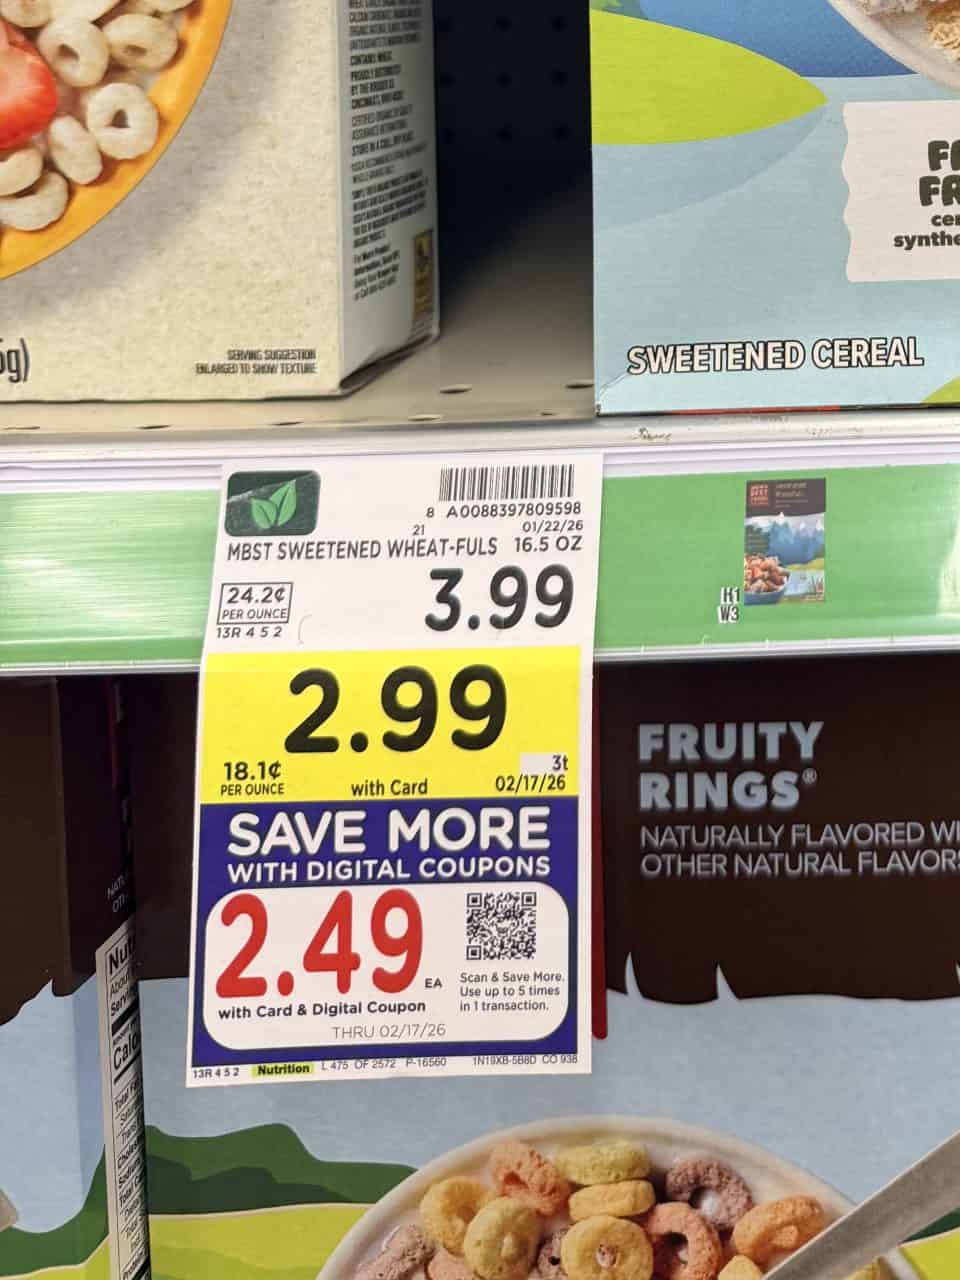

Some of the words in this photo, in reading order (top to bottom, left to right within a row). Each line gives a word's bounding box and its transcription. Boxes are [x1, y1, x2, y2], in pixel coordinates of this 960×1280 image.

[627, 339, 805, 375] SWEETENED
[812, 336, 924, 368] CEREAL
[426, 507, 435, 517] 8
[447, 502, 582, 517] A0088397809598
[412, 525, 425, 536] 21
[522, 519, 583, 534] 01/22/26
[227, 543, 271, 561] MBST
[278, 539, 380, 560] SWEETENED
[388, 537, 497, 557] WHEAT-FULS
[514, 536, 550, 553] 16.5
[555, 535, 582, 551] OZ
[227, 586, 285, 605] 24.2¢
[425, 564, 574, 631] 3.99
[222, 609, 244, 620] PER
[247, 608, 288, 619] OUNCE
[217, 627, 242, 638] 13R
[245, 627, 255, 638] 4
[259, 627, 269, 638] 5
[273, 626, 282, 637] 2
[285, 664, 507, 753] 2.99
[638, 720, 824, 761] FRUITY
[223, 760, 281, 780] 18.1¢
[552, 755, 569, 771] 3t
[221, 784, 243, 796] PER
[246, 783, 284, 795] OUNCE
[351, 780, 387, 796] with
[391, 779, 428, 796] Card
[495, 775, 566, 791] 02/17/26
[227, 809, 367, 856] SAVE
[388, 806, 551, 853] MORE
[640, 823, 786, 849] NATURALLY
[791, 821, 925, 847] FLAVORED
[227, 862, 298, 884] WITH
[306, 858, 410, 882] DIGITAL
[418, 855, 550, 879] COUPONS
[640, 852, 727, 877] OTHER
[733, 851, 851, 875] NATURAL
[216, 889, 423, 999] 2.49
[424, 978, 442, 989] EA
[460, 972, 488, 983] Scan
[491, 972, 499, 982] &
[503, 972, 530, 982] Save
[534, 972, 565, 982] More.
[460, 986, 481, 997] Use
[485, 987, 500, 999] up
[503, 986, 515, 996] to
[519, 986, 526, 996] 5
[529, 985, 560, 996] times
[218, 1004, 251, 1019] with
[256, 1003, 293, 1018] Card
[298, 1003, 307, 1016] &
[312, 1001, 362, 1019] Digital
[366, 1000, 426, 1017] Coupon
[481, 1000, 549, 1011] transaction.
[332, 1026, 375, 1040] THRU
[379, 1023, 446, 1039] 02/17/26
[257, 1063, 310, 1076] Nutrition
[354, 1060, 369, 1070] OF
